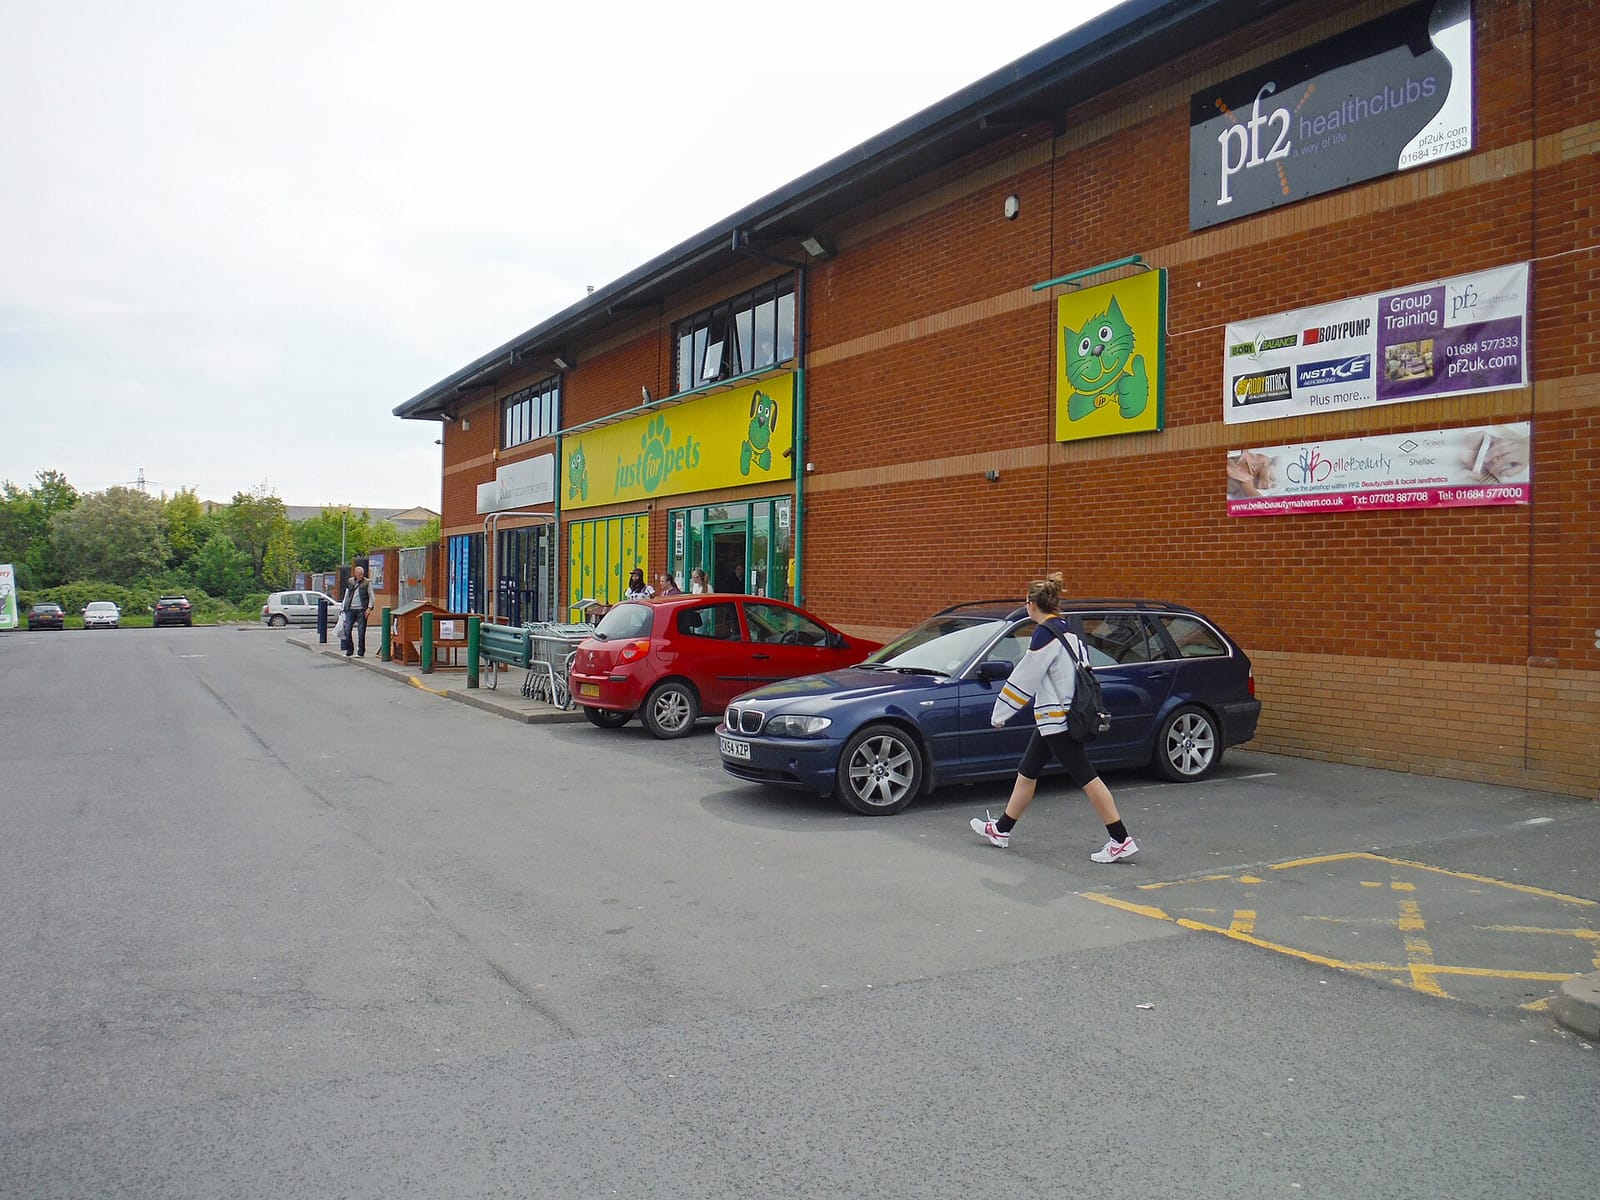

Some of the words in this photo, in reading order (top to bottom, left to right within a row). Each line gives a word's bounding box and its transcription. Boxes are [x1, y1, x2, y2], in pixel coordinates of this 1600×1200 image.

[1217, 81, 1291, 205] pf2
[1300, 76, 1436, 140] healthclubs
[1418, 126, 1468, 149] pf2uk.com
[1401, 148, 1429, 164] 01684
[1432, 137, 1468, 155] 577333
[1391, 294, 1432, 312] Group
[1451, 284, 1478, 319] pf2
[1319, 318, 1371, 343] BODYPUMP
[1384, 310, 1438, 330] Training
[1232, 343, 1253, 355] BODY
[1263, 336, 1296, 349] BALANCE
[1446, 343, 1478, 356] 01684
[1481, 336, 1519, 351] 577333
[1448, 354, 1517, 377] pf2uk.com
[1310, 394, 1330, 406] Plus
[1333, 391, 1370, 403] more...
[613, 454, 642, 496] just
[646, 454, 661, 480] for
[663, 435, 701, 481] pets
[1369, 493, 1395, 504] 07702
[1396, 491, 1428, 502] 887708
[1437, 490, 1454, 500] Tel:
[1456, 489, 1484, 500] 01684
[1486, 487, 1523, 498] 577000
[735, 743, 748, 757] XZP
